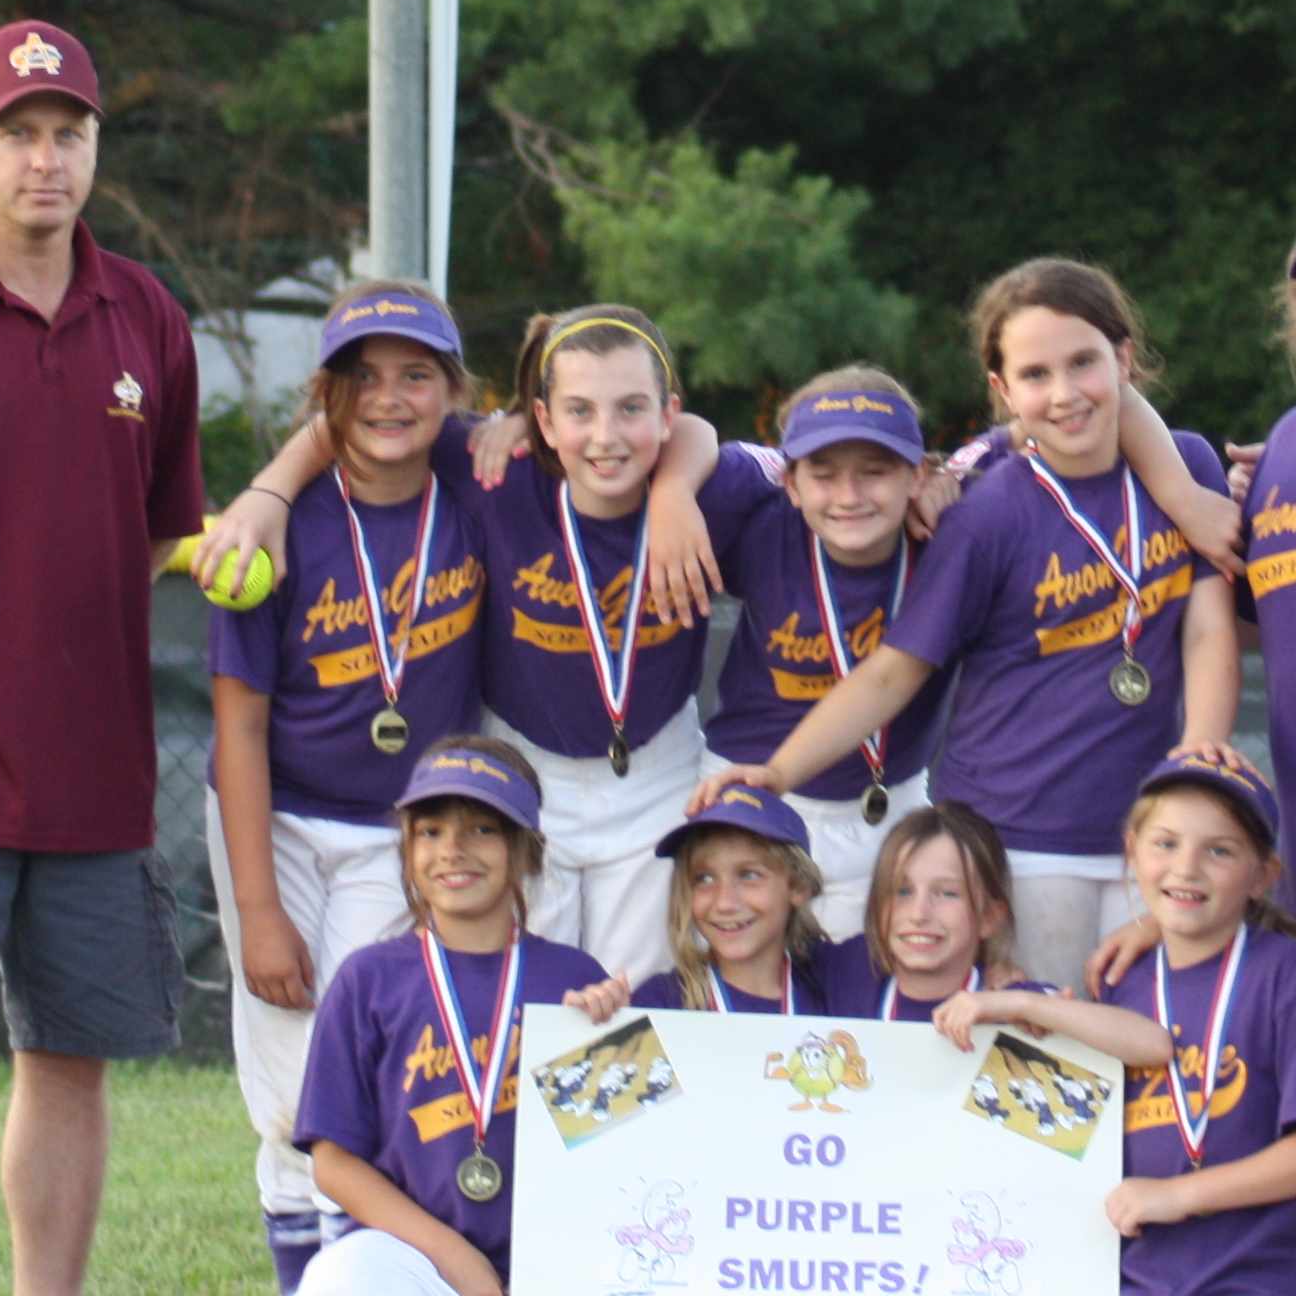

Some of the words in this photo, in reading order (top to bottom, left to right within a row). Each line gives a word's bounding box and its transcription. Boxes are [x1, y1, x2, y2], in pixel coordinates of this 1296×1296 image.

[782, 1132, 847, 1168] GO
[725, 1196, 903, 1236] PURPLE
[717, 1257, 931, 1296] SMURFS!
